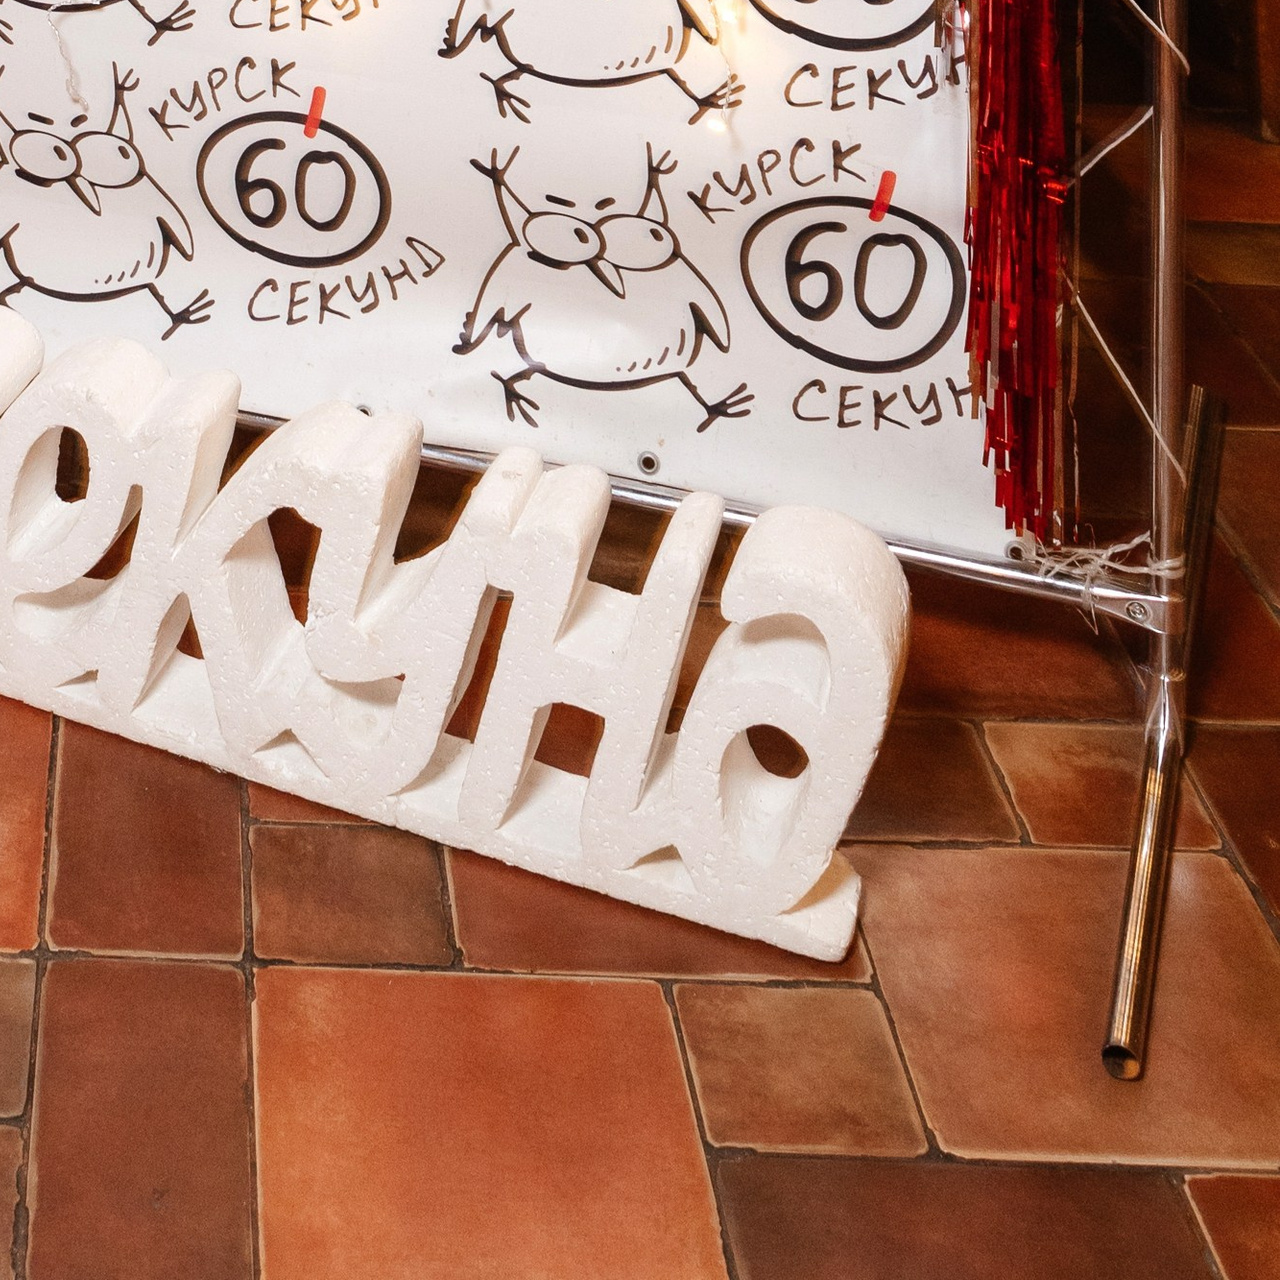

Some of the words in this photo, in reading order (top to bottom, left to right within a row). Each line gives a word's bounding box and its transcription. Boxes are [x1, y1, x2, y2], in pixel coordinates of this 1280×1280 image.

[148, 56, 300, 141] КУРСК
[235, 138, 356, 232] 60
[686, 137, 868, 223] КУРСК
[247, 236, 445, 324] СЕКУНД
[784, 221, 927, 329] 60
[792, 377, 975, 431] СЕКУН
